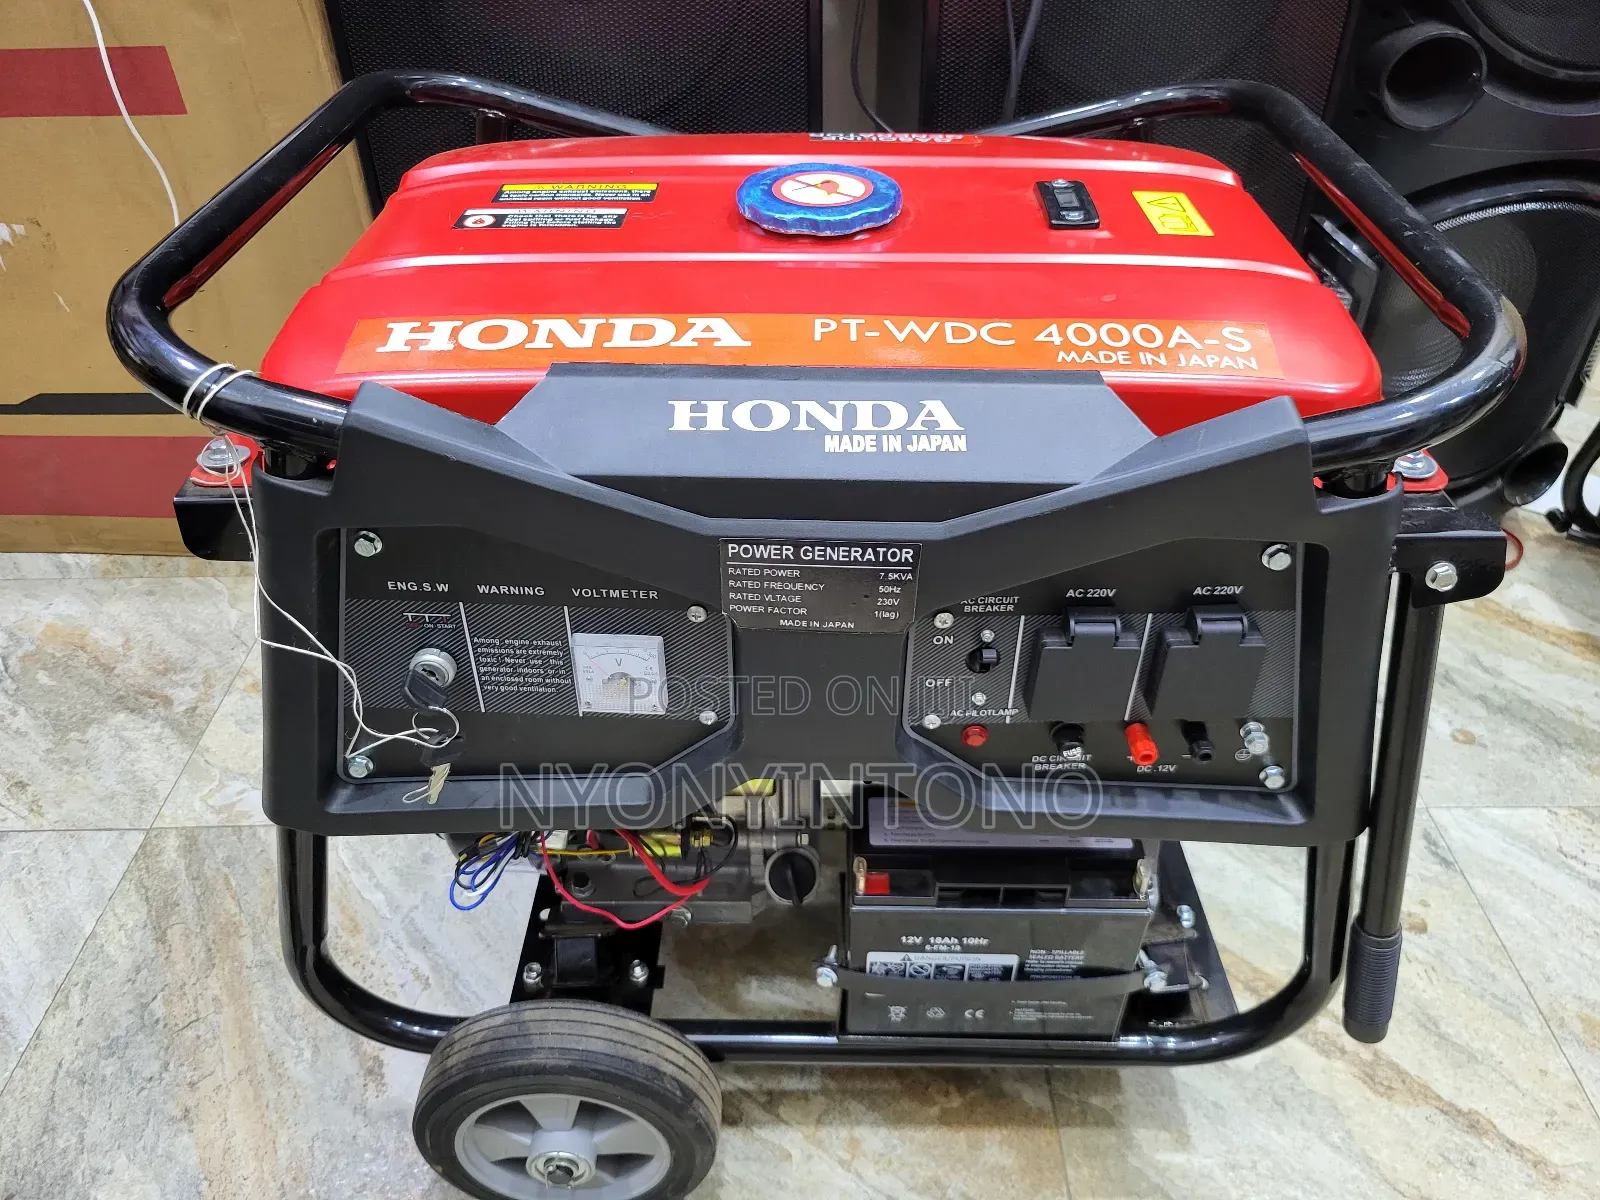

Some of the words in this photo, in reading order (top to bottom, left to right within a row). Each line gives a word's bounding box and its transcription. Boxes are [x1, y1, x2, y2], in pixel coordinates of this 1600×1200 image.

[376, 317, 752, 353] HONDA
[813, 318, 1016, 346] PT-WDC
[1034, 322, 1252, 353] 4000A-S
[1057, 350, 1132, 365] MADE
[1139, 352, 1167, 366] IN
[1177, 354, 1258, 370] JAPAN
[668, 400, 965, 431] HONDA
[824, 434, 876, 452] MADE
[882, 434, 902, 452] IN
[906, 434, 967, 452] JAPAN
[728, 544, 794, 559] POWER
[800, 546, 914, 563] GENERATOR
[728, 568, 760, 576] RATED
[764, 569, 800, 578] POWER
[387, 580, 450, 592] ENG.S.W
[477, 584, 545, 596] WARNING
[728, 580, 760, 589] RATED
[764, 582, 825, 591] FREQUENCY
[1193, 586, 1212, 595] AC
[1213, 586, 1243, 594] 220V
[572, 588, 659, 600] VOLTMETER
[1066, 589, 1084, 597] AC
[1086, 588, 1116, 597] 220V
[764, 594, 801, 603] VLTAGE
[730, 605, 765, 614] POWER
[768, 606, 807, 615] FACTOR
[874, 611, 899, 619] 1(lag)
[822, 621, 855, 629] JAPAN
[473, 637, 500, 645] Among
[933, 636, 954, 644] ON
[615, 658, 622, 667] V
[926, 679, 952, 687] OFF
[966, 708, 1019, 716] PILOTLAMP
[1034, 763, 1086, 771] BREAKER
[900, 936, 923, 944] 12V
[928, 937, 958, 945] 18Ah
[962, 937, 990, 946] 10Hr
